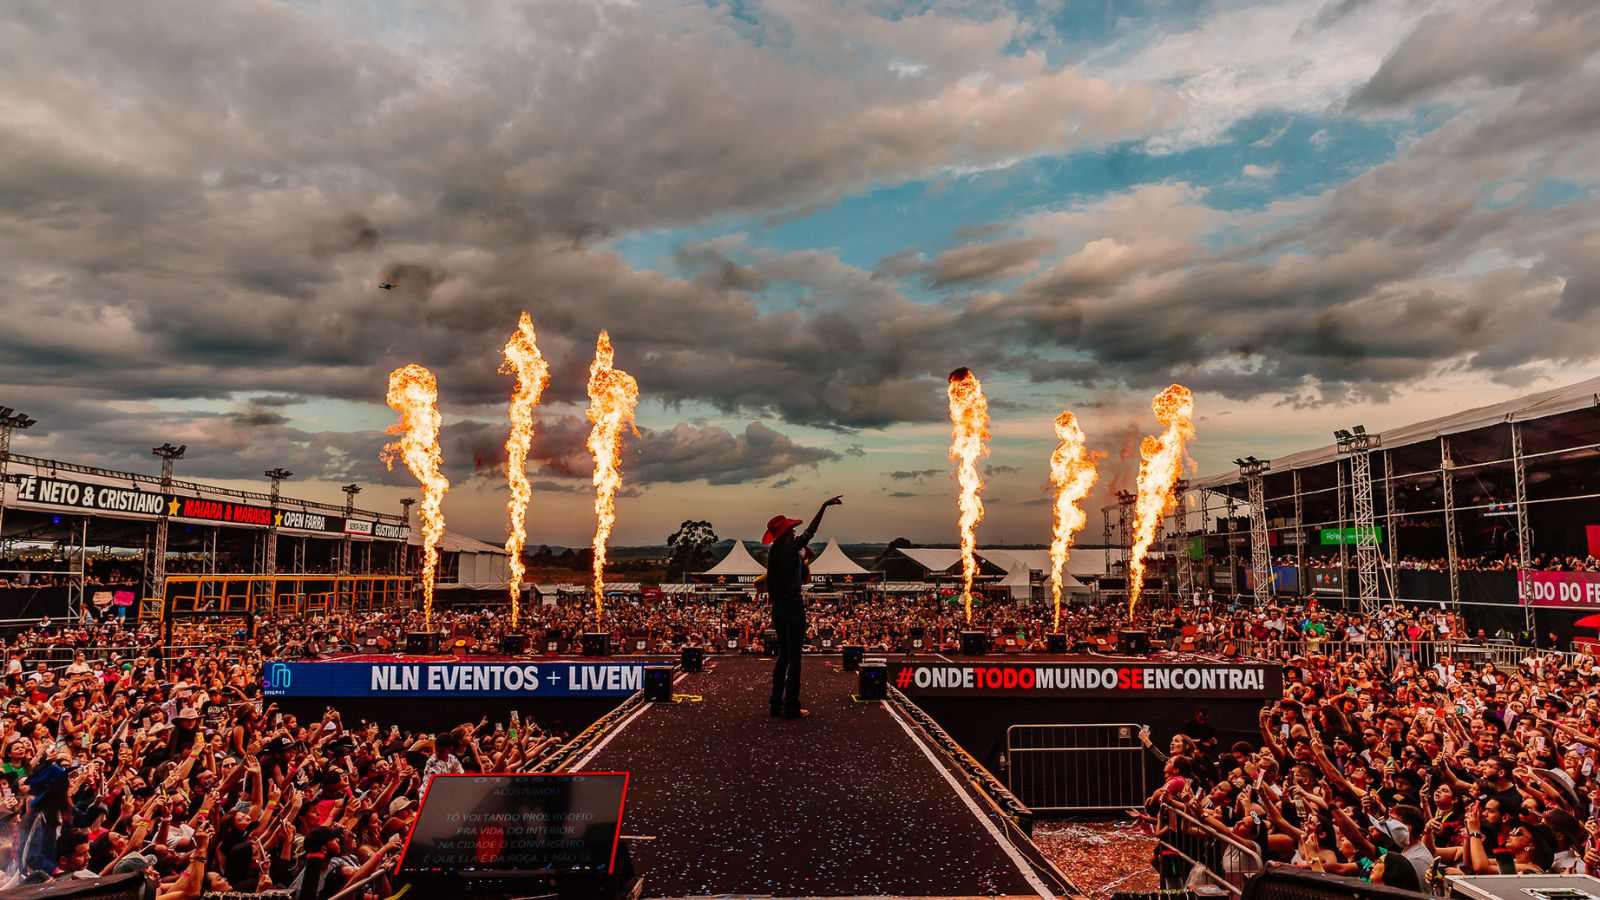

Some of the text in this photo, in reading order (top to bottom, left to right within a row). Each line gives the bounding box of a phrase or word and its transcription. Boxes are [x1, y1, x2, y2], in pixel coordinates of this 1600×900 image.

[18, 476, 164, 514] ZÉ NETO & CRISTIANO
[184, 499, 223, 521] MAIARA
[284, 512, 326, 530] OPEN FARRA
[1559, 582, 1582, 603] DO
[371, 665, 642, 690] NLN EVENTOS + LIVEM
[897, 667, 1265, 690] #ONDETODOMUNDOSEENCONTRA!
[480, 826, 504, 835] VIDA
[457, 839, 498, 848] CIDADE
